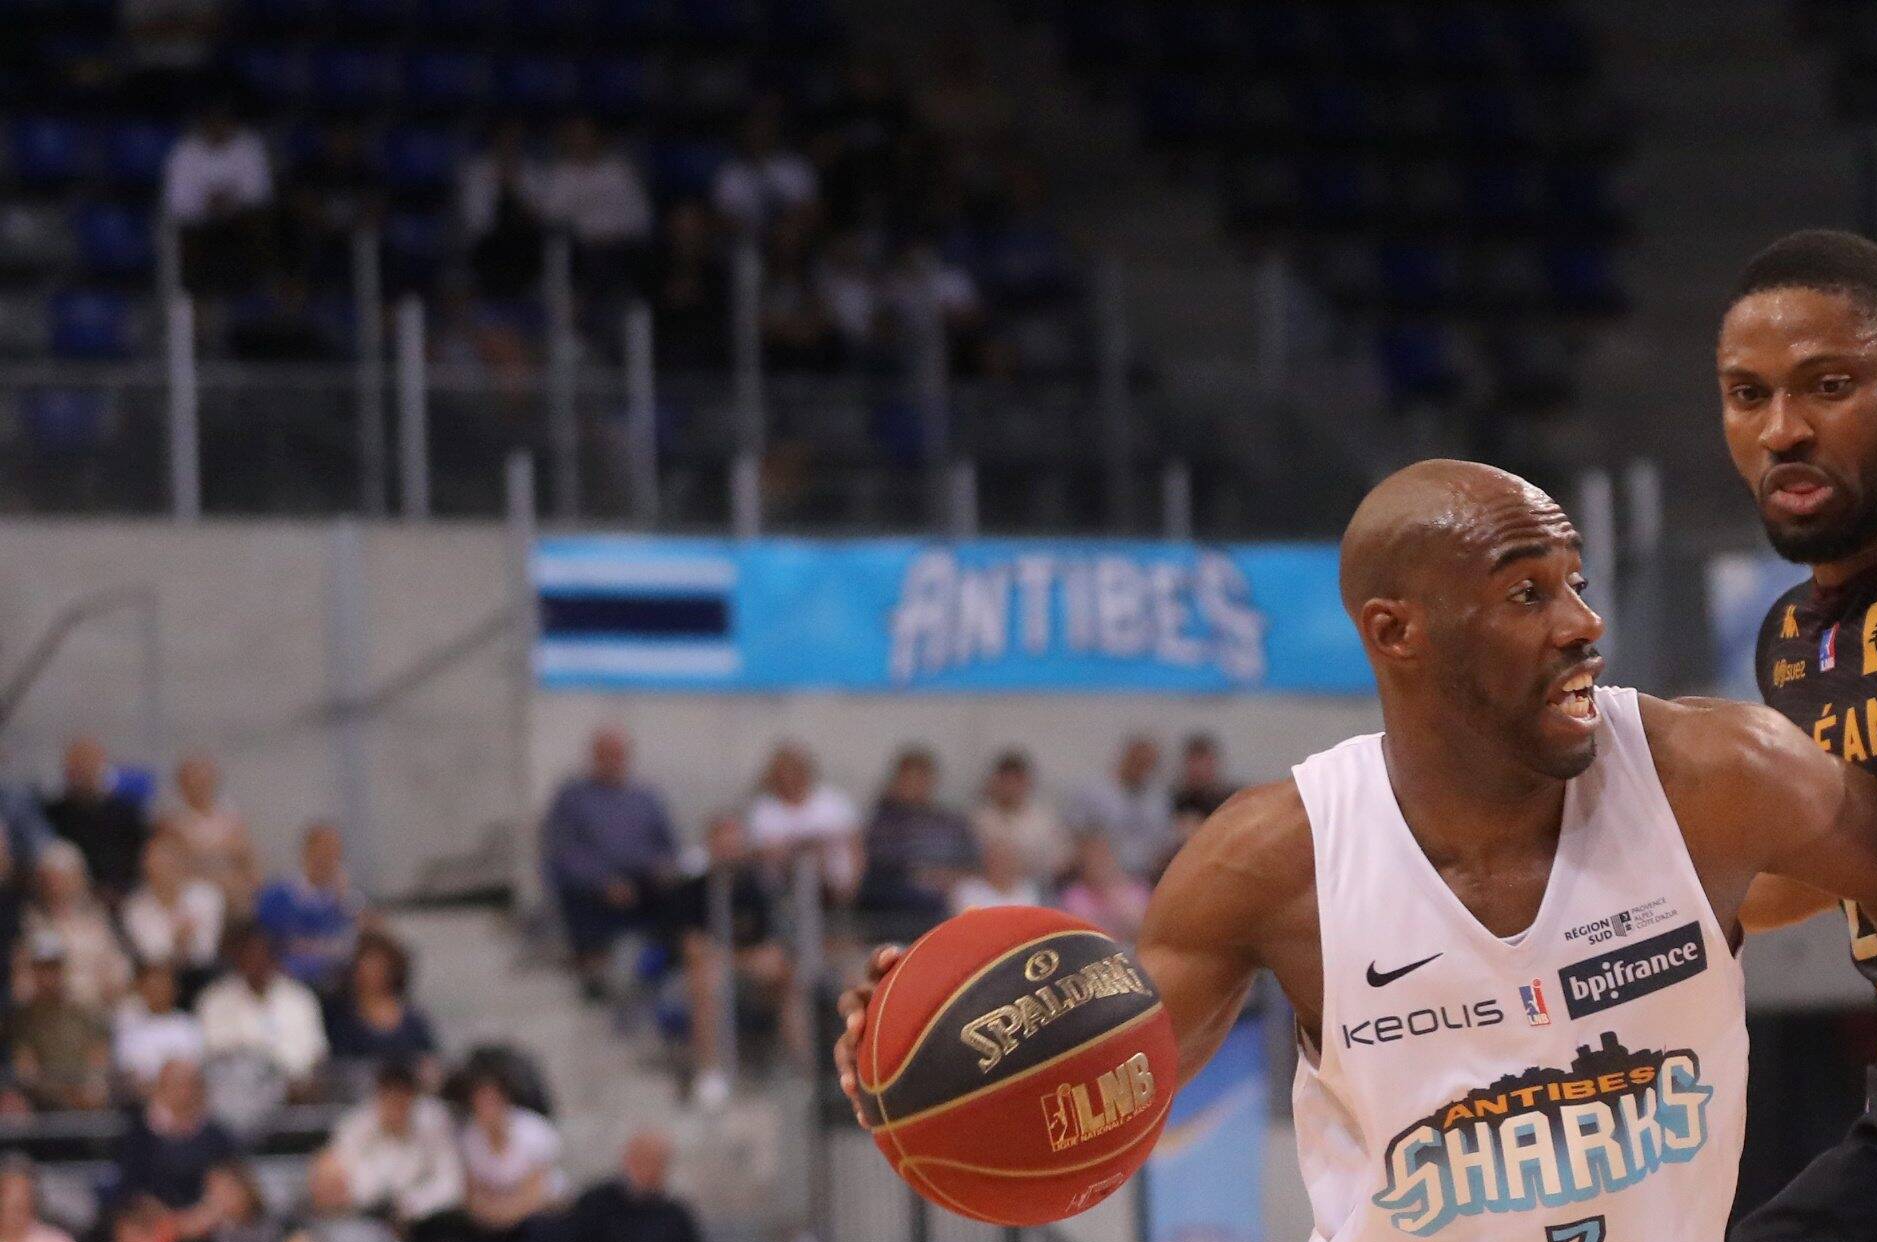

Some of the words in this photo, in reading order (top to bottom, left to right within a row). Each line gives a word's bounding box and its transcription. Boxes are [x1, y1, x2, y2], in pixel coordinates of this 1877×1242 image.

[889, 548, 1266, 688] ANTIBES
[1564, 918, 1610, 941] RÉGION
[1589, 931, 1613, 946] SUD
[1569, 941, 1699, 1002] bpifrance
[1072, 1051, 1154, 1136] LNB
[1442, 1065, 1656, 1130] ANTIBES
[1373, 1048, 1714, 1238] SHARKS
